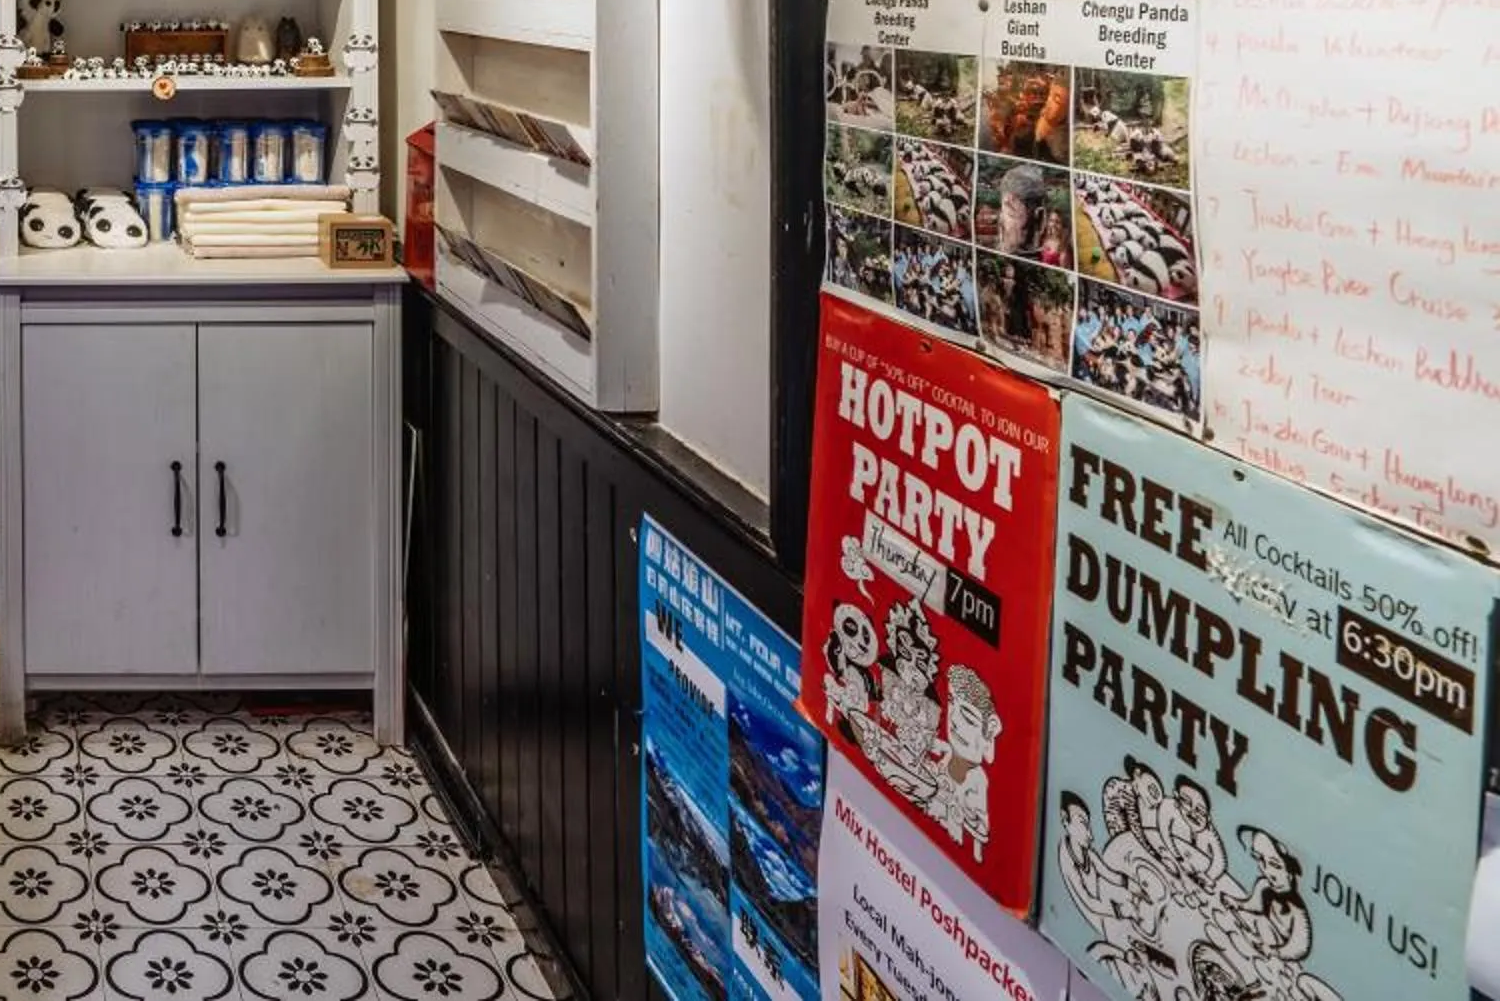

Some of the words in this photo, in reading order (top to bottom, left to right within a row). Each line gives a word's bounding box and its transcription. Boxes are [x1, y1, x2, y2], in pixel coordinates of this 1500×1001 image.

[873, 11, 916, 31] Breeding
[877, 30, 911, 47] Center
[1007, 19, 1041, 38] Giant
[1081, 0, 1135, 24] Chengu
[1138, 2, 1189, 22] Panda
[1098, 24, 1167, 50] Breeding
[1001, 39, 1047, 60] Buddha
[1104, 48, 1157, 70] Center
[932, 384, 978, 421] COCKTAIL
[980, 408, 996, 428] TO
[838, 361, 1022, 512] HOTPOT
[849, 440, 996, 582] PARTY
[1068, 442, 1213, 574] FREE
[869, 521, 938, 603] Thursday
[1223, 519, 1248, 550] All
[1255, 533, 1352, 601] Cocktails
[1362, 584, 1423, 638] 50%
[1434, 625, 1478, 664] off!
[950, 571, 996, 630] 7pm
[1067, 531, 1417, 793] DUMPLING
[1307, 609, 1333, 641] at
[1343, 620, 1466, 711] 6:30pm
[1062, 621, 1250, 798] PARTY
[835, 798, 863, 838] Mix
[865, 835, 917, 898] Hostel
[920, 886, 1035, 1001] Poshpacke
[853, 883, 888, 934] Local
[1311, 864, 1377, 935] JOIN
[1387, 915, 1438, 979] US!
[845, 909, 881, 964] Every
